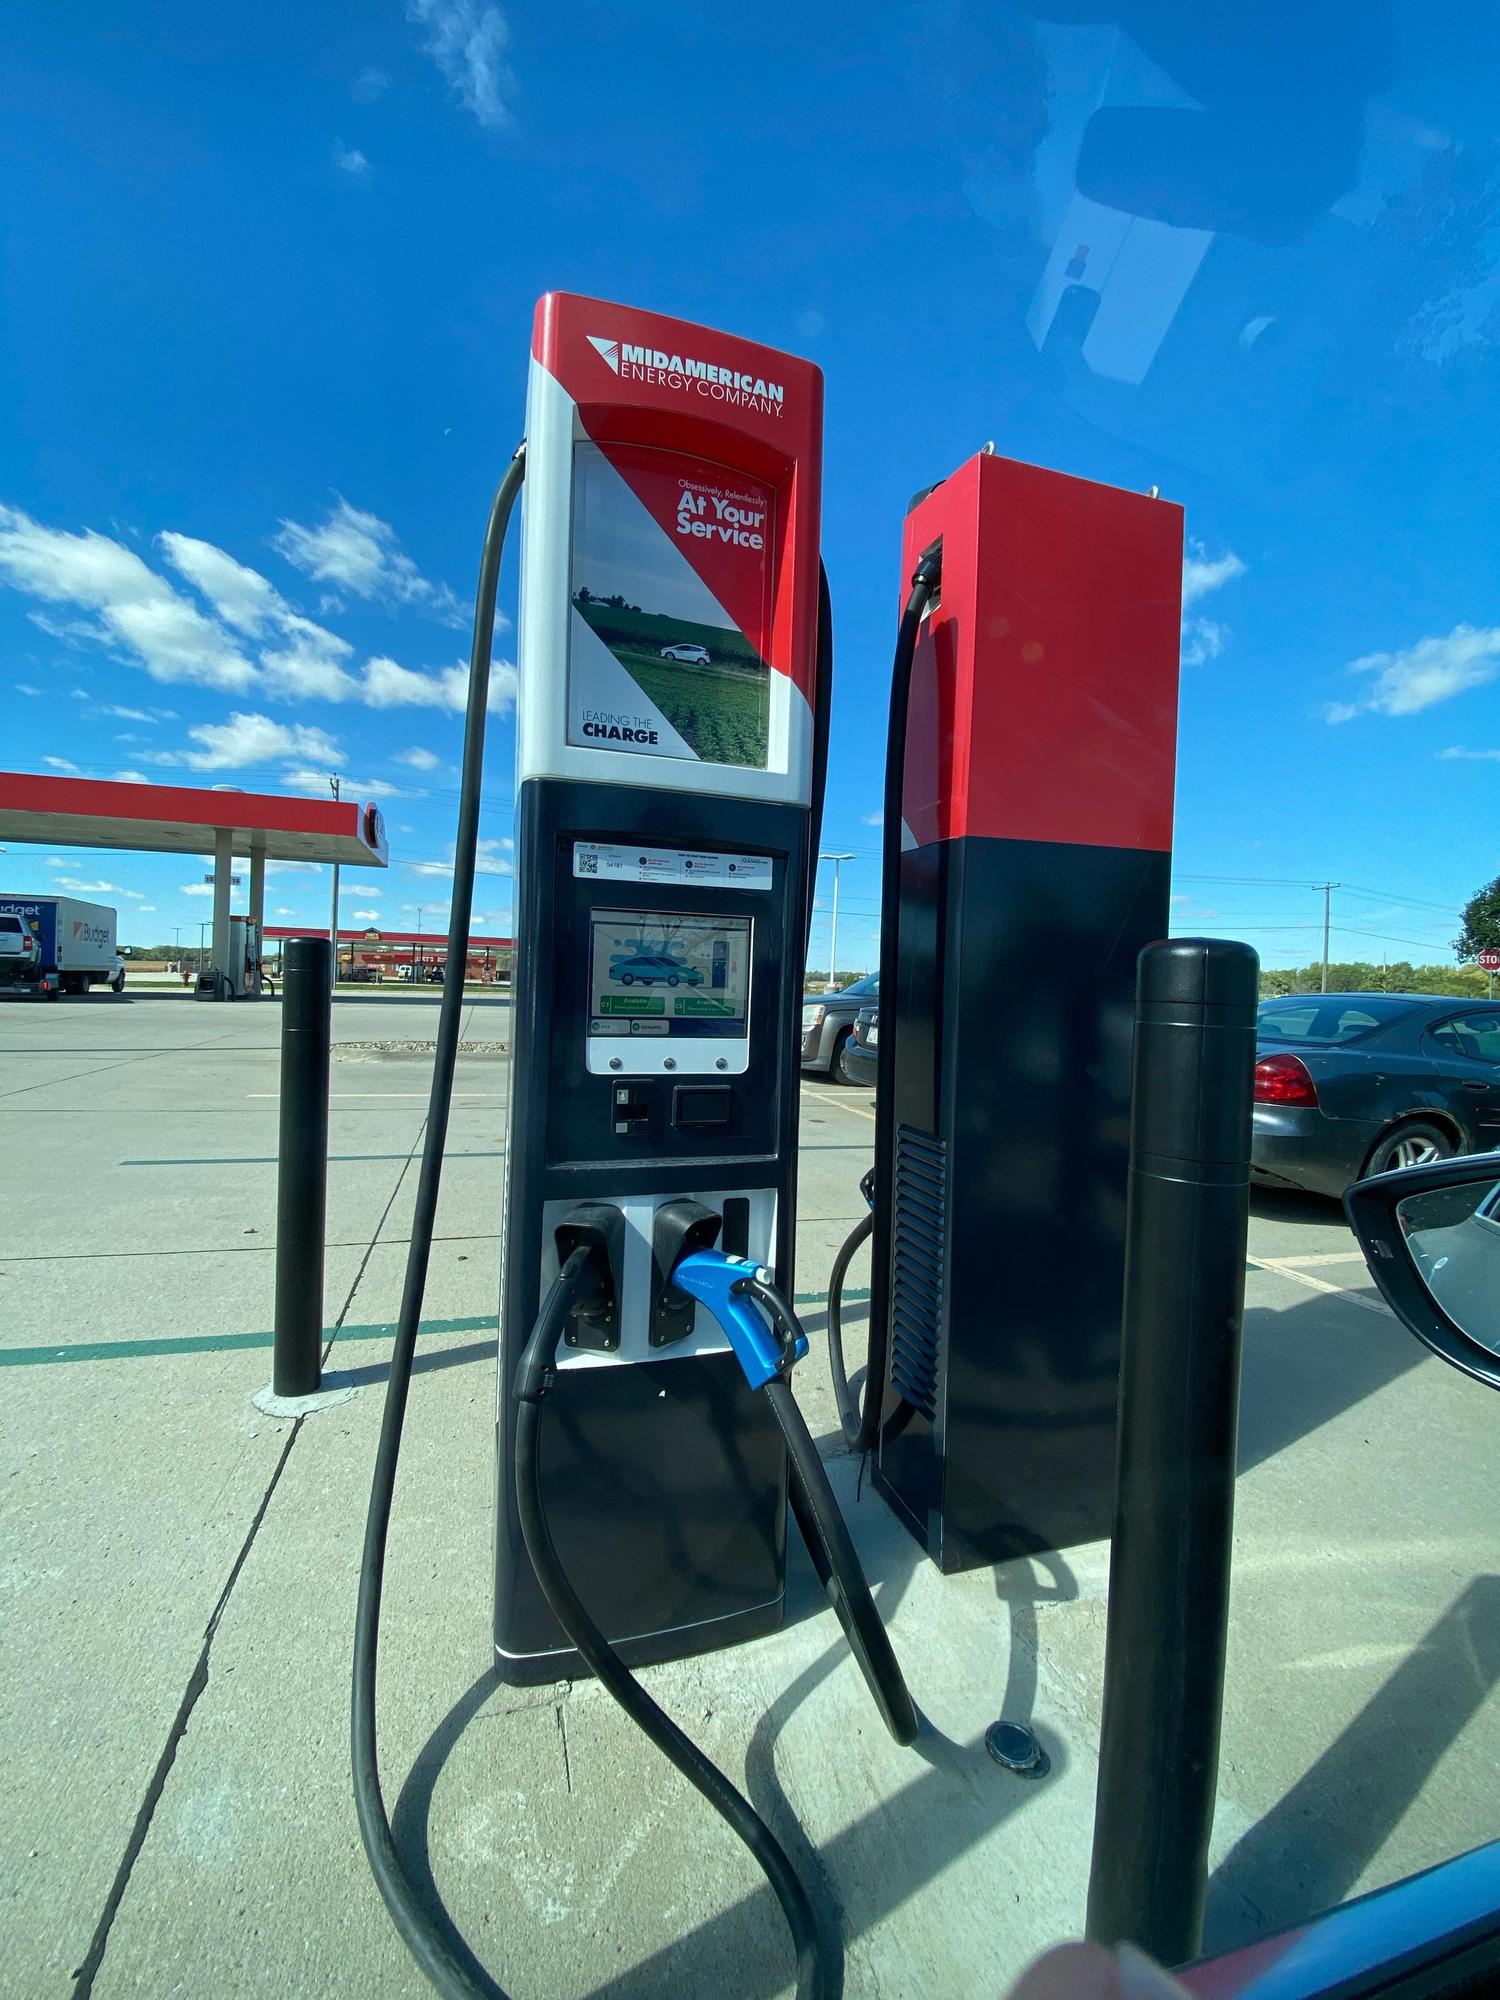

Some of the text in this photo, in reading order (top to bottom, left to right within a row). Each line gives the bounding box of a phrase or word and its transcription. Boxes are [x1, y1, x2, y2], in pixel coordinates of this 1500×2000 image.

[621, 343, 784, 402] MIDAMERICAN
[621, 362, 693, 392] ENERGY
[677, 490, 765, 528] At Your
[676, 511, 765, 550] Service
[582, 710, 652, 730] LEADING THE
[582, 722, 659, 746] CHARGE
[84, 923, 110, 948] Budget
[1480, 956, 1500, 964] STO
